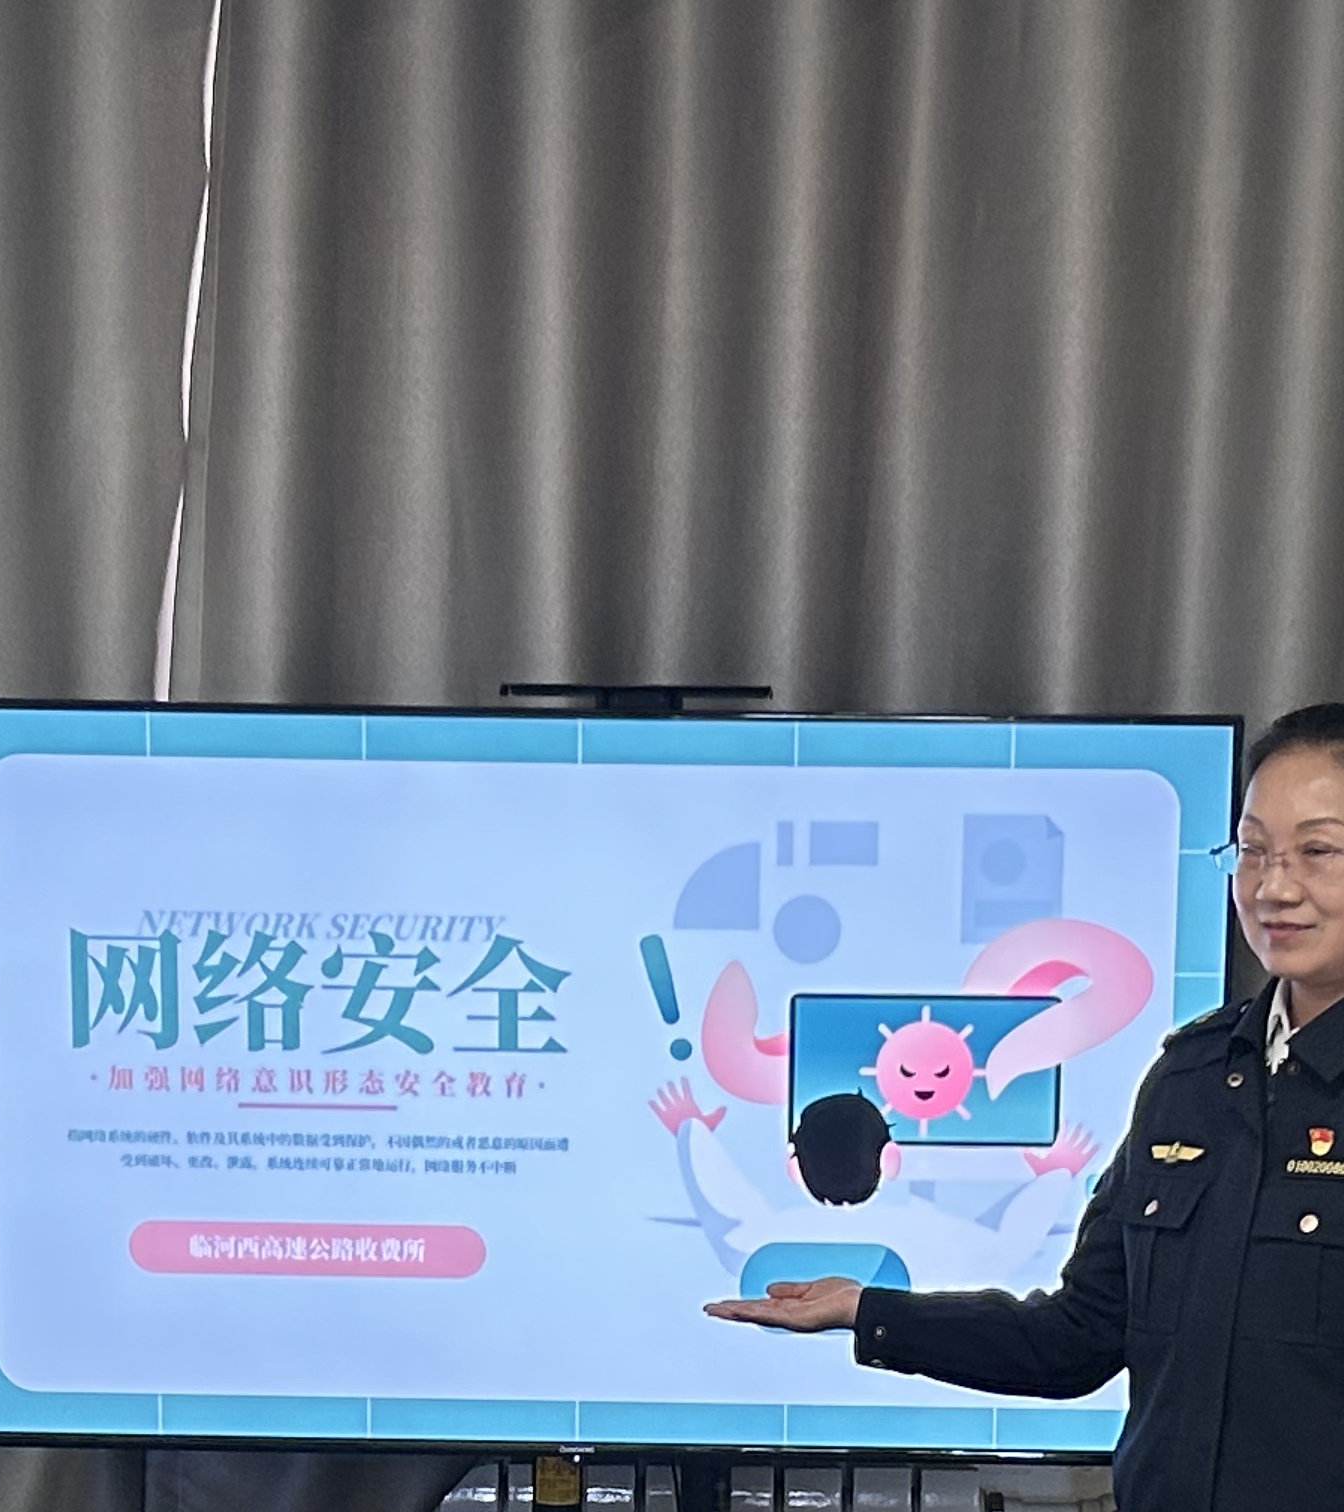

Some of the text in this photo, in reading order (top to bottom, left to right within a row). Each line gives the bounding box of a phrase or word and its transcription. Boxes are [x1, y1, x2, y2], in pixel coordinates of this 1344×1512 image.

[137, 909, 507, 942] NETWORK SECURITY
[69, 927, 572, 1055] 网络安全
[188, 1233, 426, 1263] 临河西高速公路收费所
